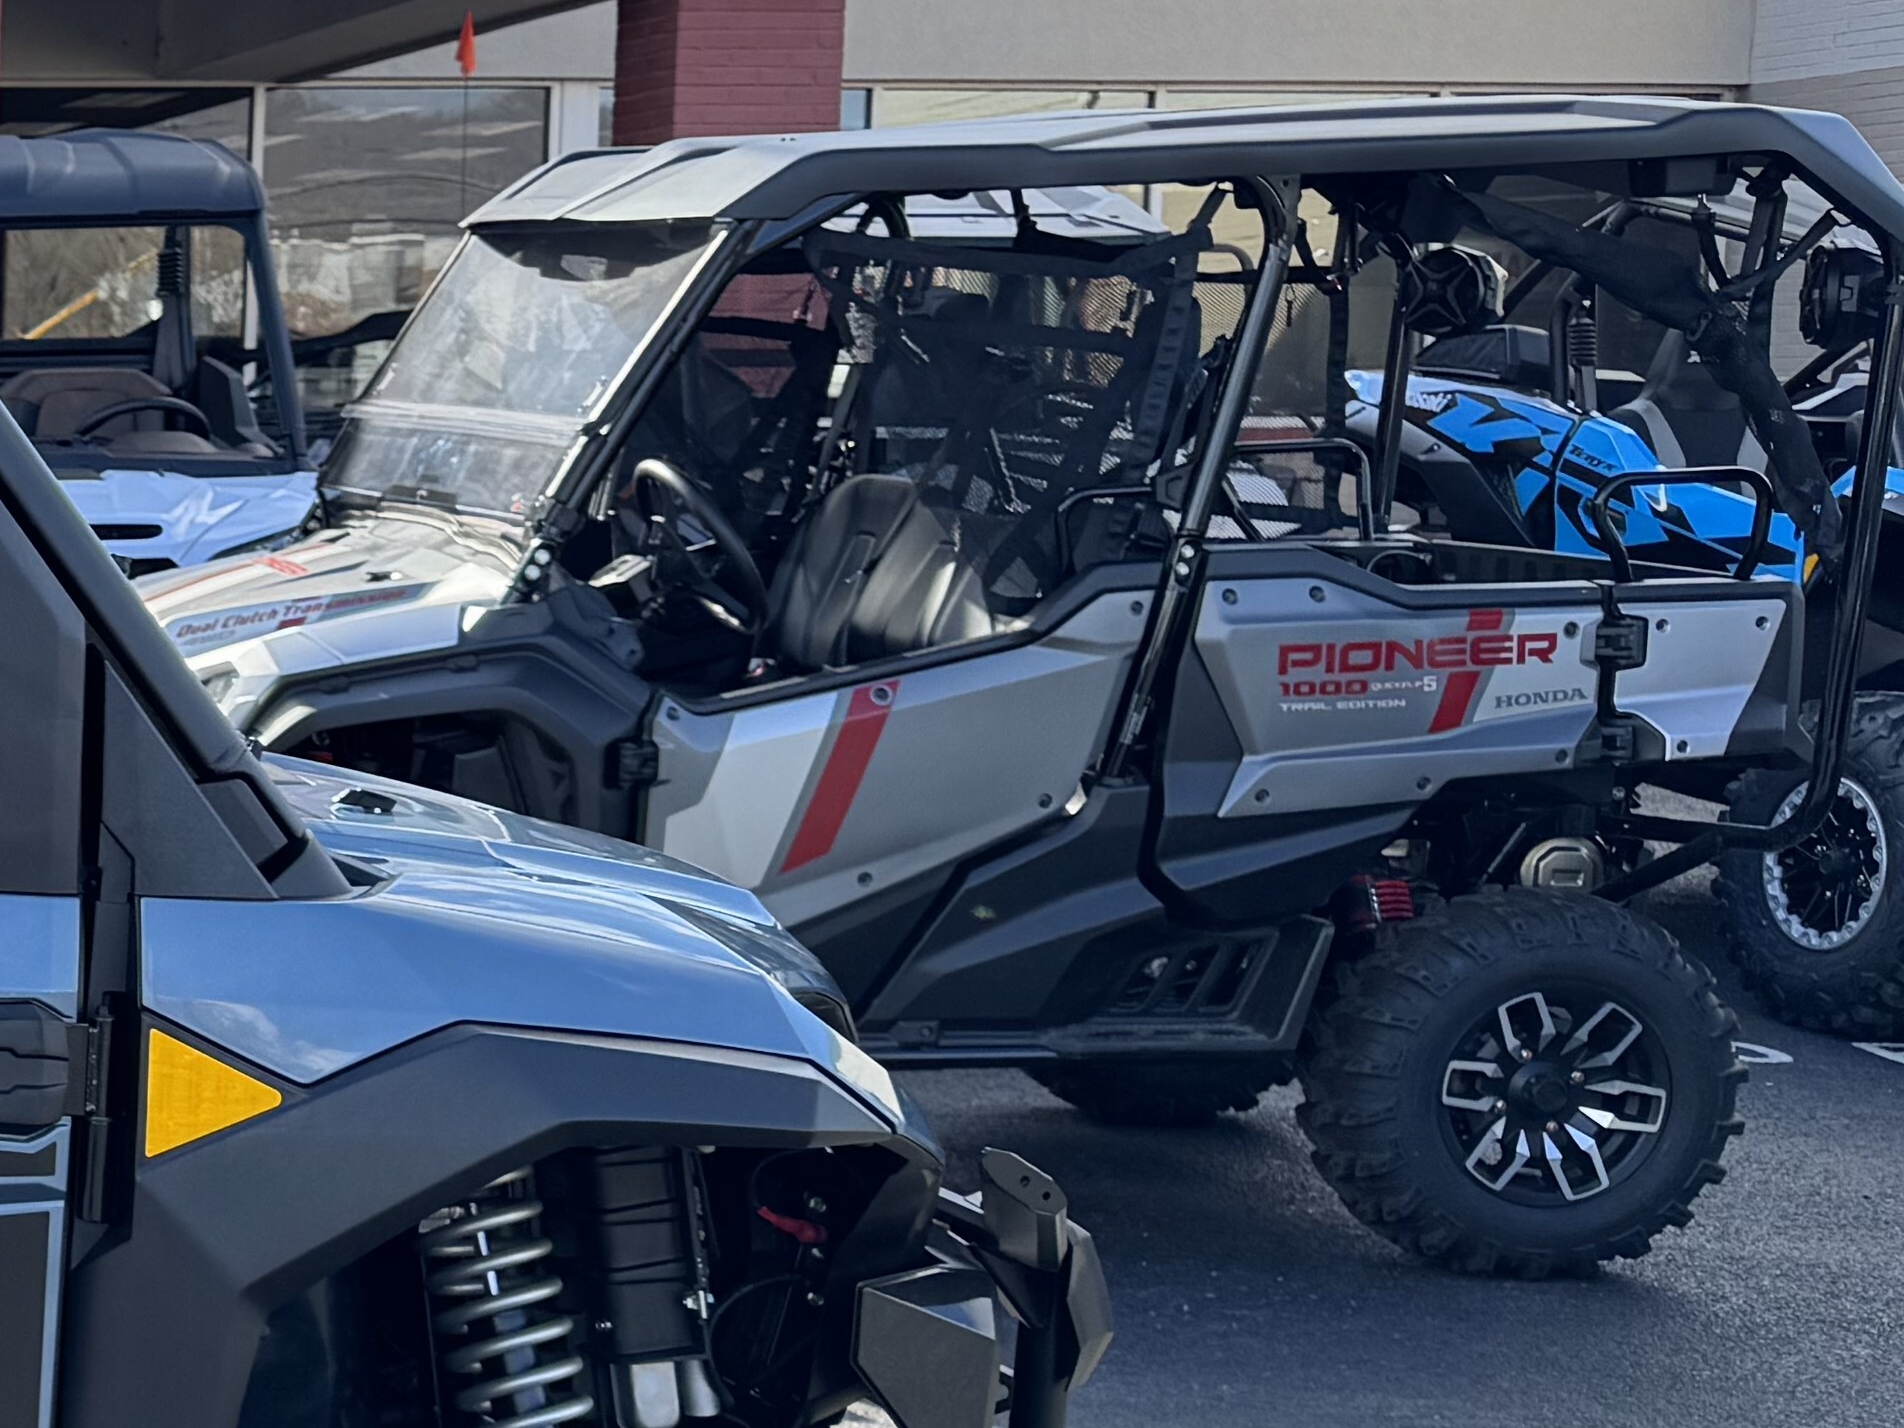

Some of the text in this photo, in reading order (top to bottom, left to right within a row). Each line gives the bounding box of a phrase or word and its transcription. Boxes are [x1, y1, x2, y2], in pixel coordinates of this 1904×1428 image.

[176, 613, 216, 638] Dual
[221, 608, 279, 629] Clutch
[1277, 632, 1558, 675] PIONEER
[1278, 679, 1369, 697] 1000
[1494, 686, 1589, 710] HONDA
[1278, 698, 1407, 712] TRAIL EDITION
